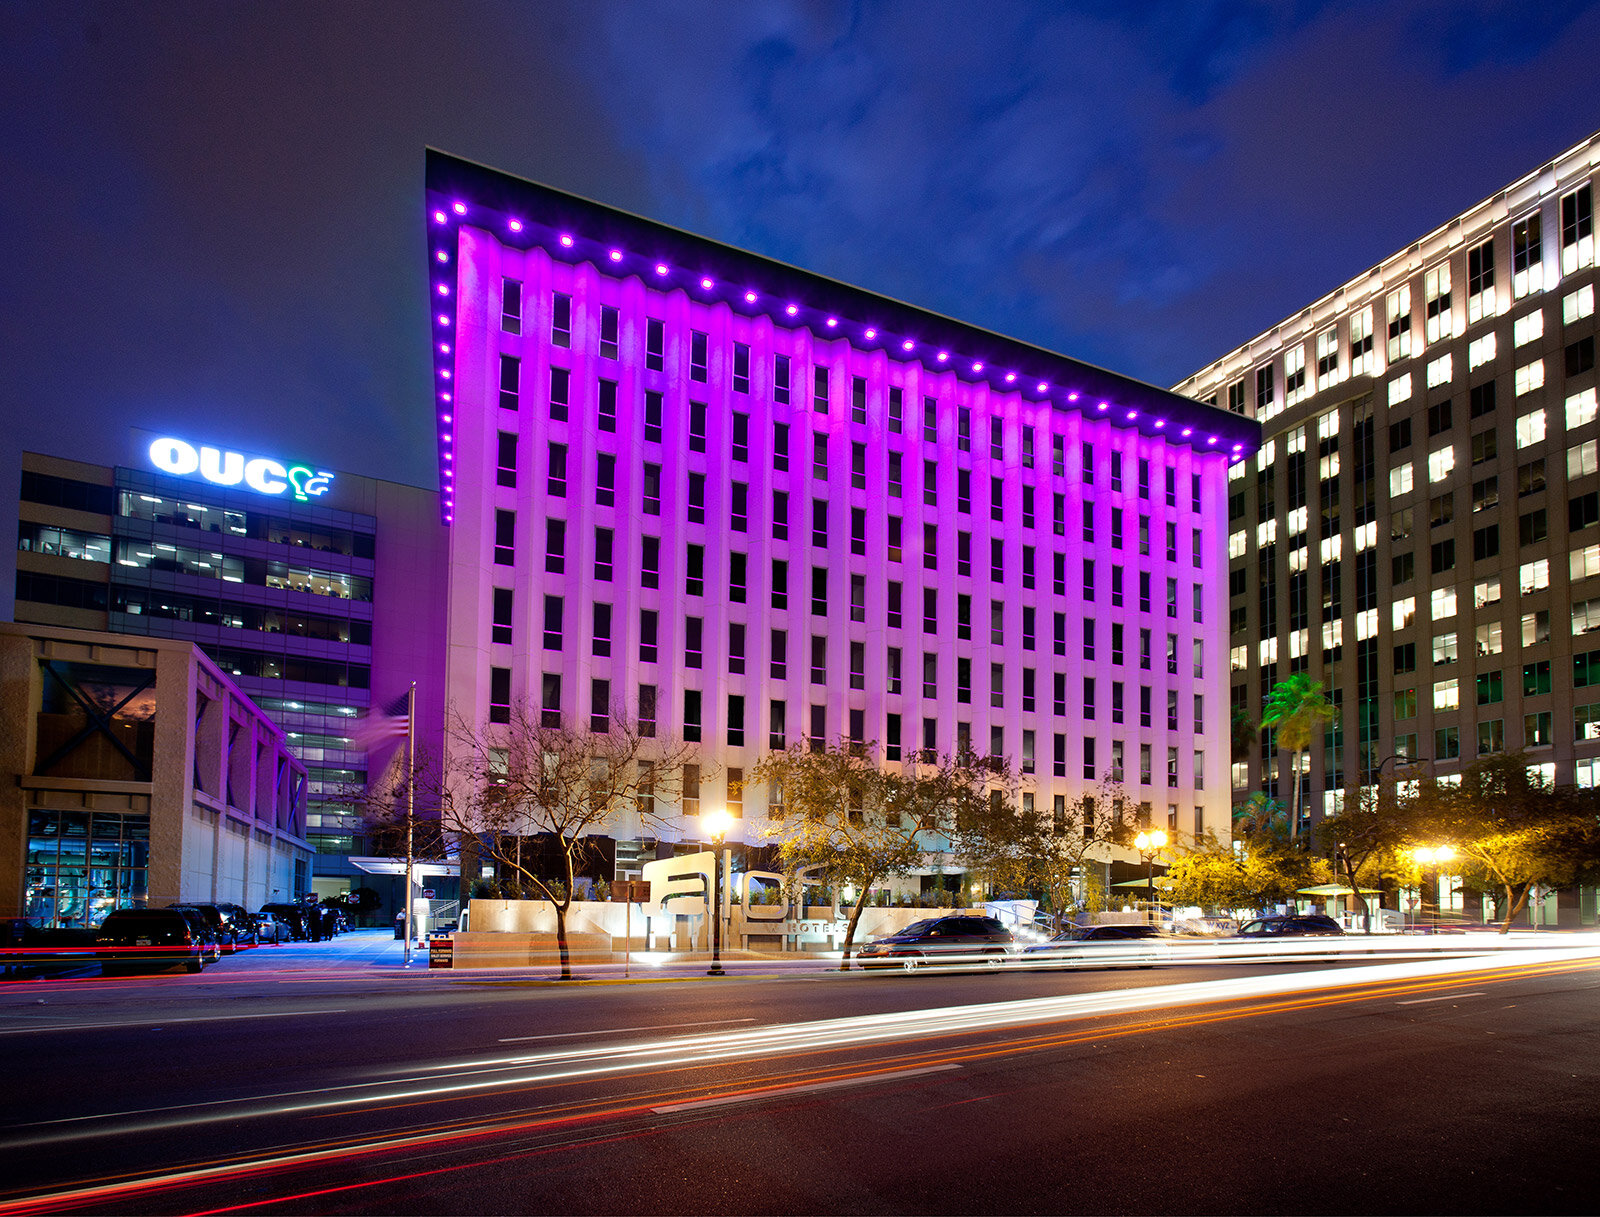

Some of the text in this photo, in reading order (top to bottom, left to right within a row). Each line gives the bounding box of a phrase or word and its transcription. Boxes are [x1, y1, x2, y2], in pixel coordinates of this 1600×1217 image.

[149, 437, 287, 494] OUC
[640, 849, 847, 919] aloft
[788, 923, 849, 932] HOTELS
